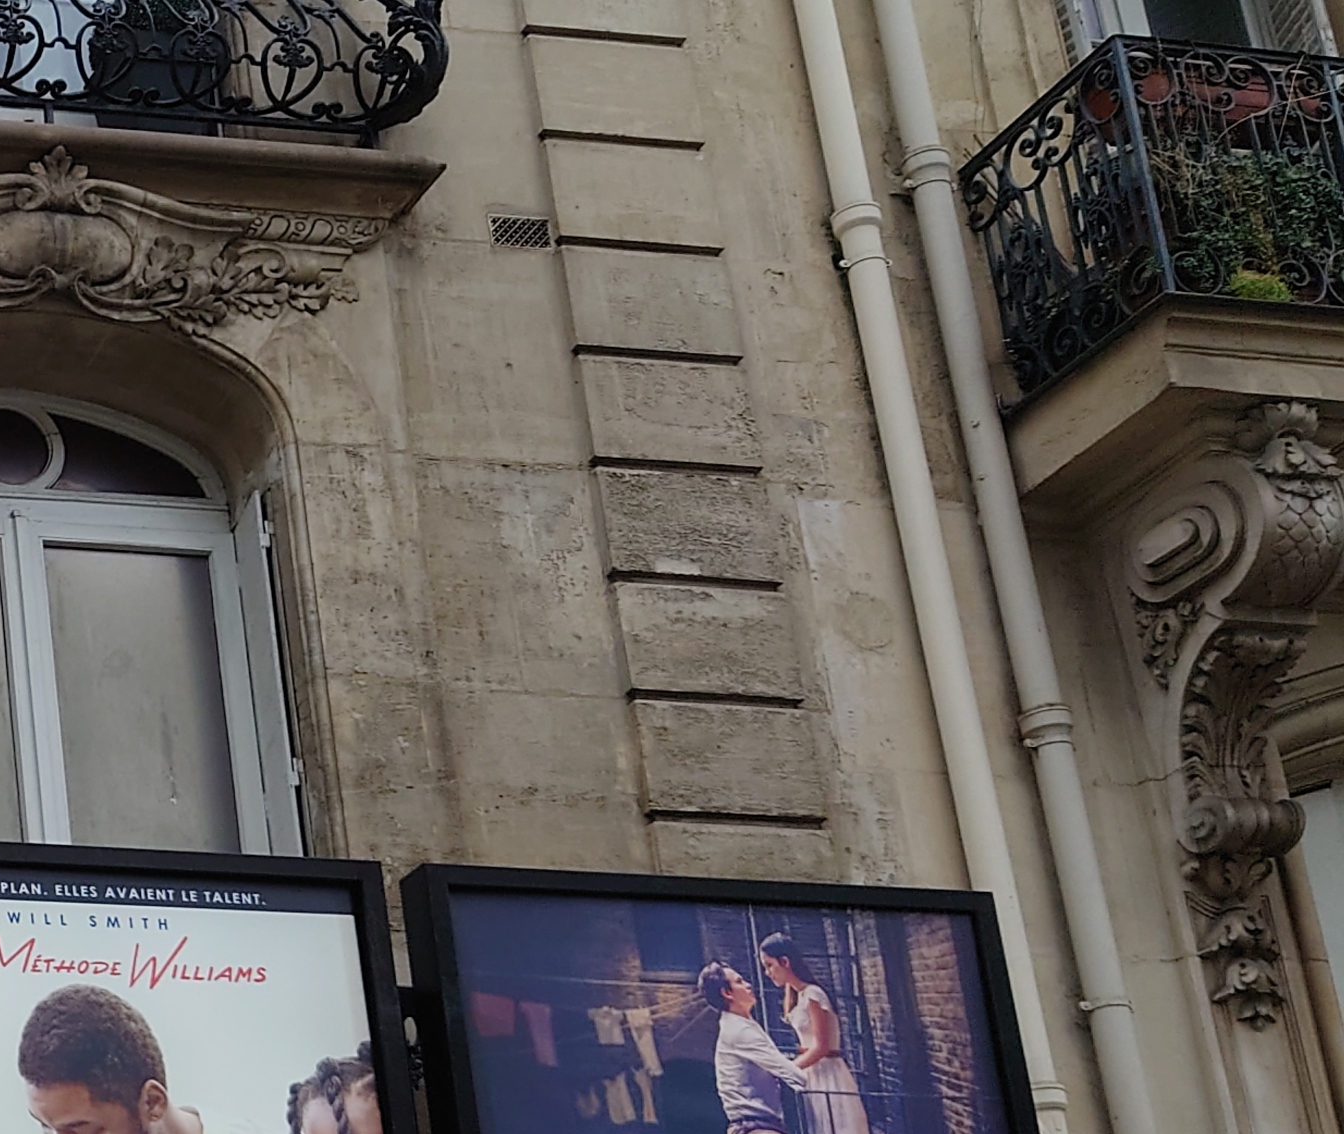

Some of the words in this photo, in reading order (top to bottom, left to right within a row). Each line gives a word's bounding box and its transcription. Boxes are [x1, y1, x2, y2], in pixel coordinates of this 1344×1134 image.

[0, 882, 48, 896] PLAN.
[55, 884, 98, 897] ELLES
[105, 887, 175, 901] AVAIENT
[182, 889, 198, 902] LE
[204, 891, 267, 905] TALENT.
[7, 911, 67, 926] WILL
[89, 915, 169, 930] SMITH
